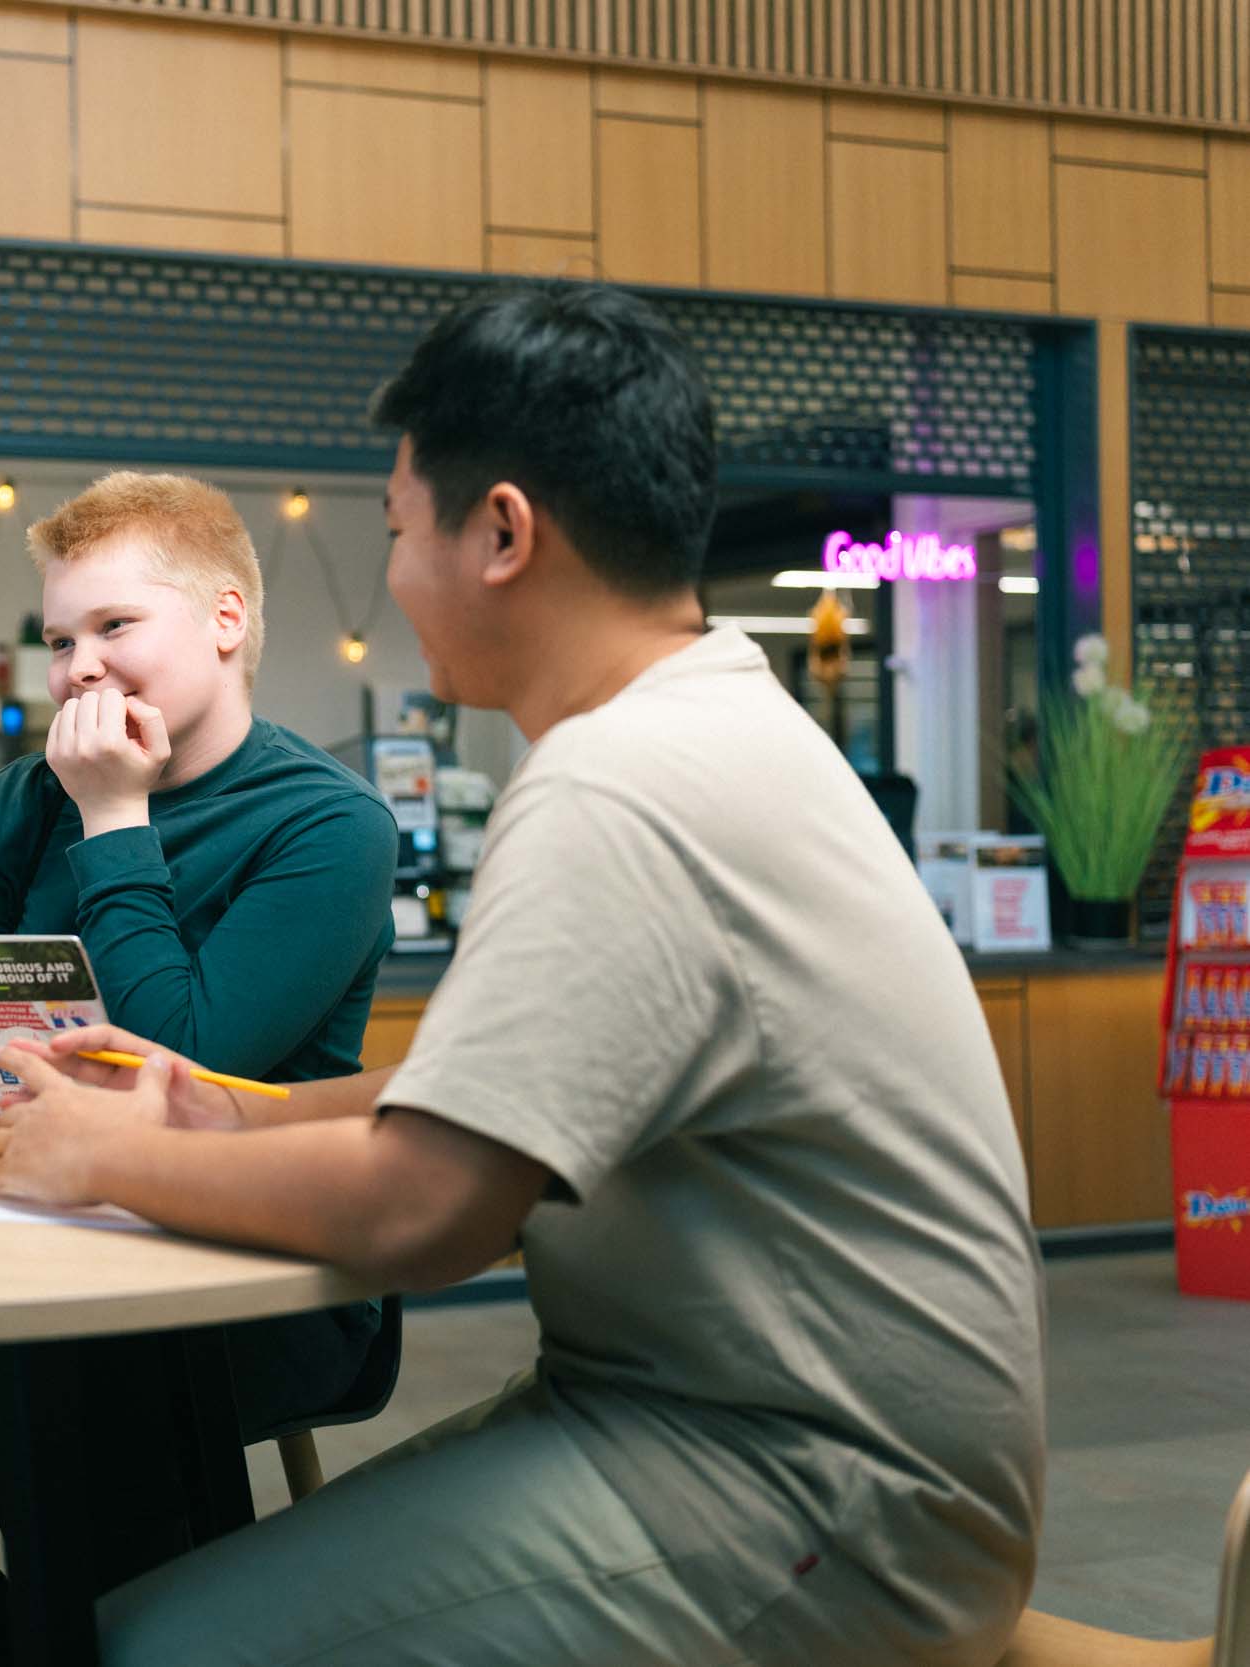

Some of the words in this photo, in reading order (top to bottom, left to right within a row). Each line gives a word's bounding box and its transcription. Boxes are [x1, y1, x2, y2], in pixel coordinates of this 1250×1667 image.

[823, 529, 902, 581] Good
[46, 962, 75, 973] AND
[37, 973, 55, 983] OF
[57, 972, 70, 983] IT
